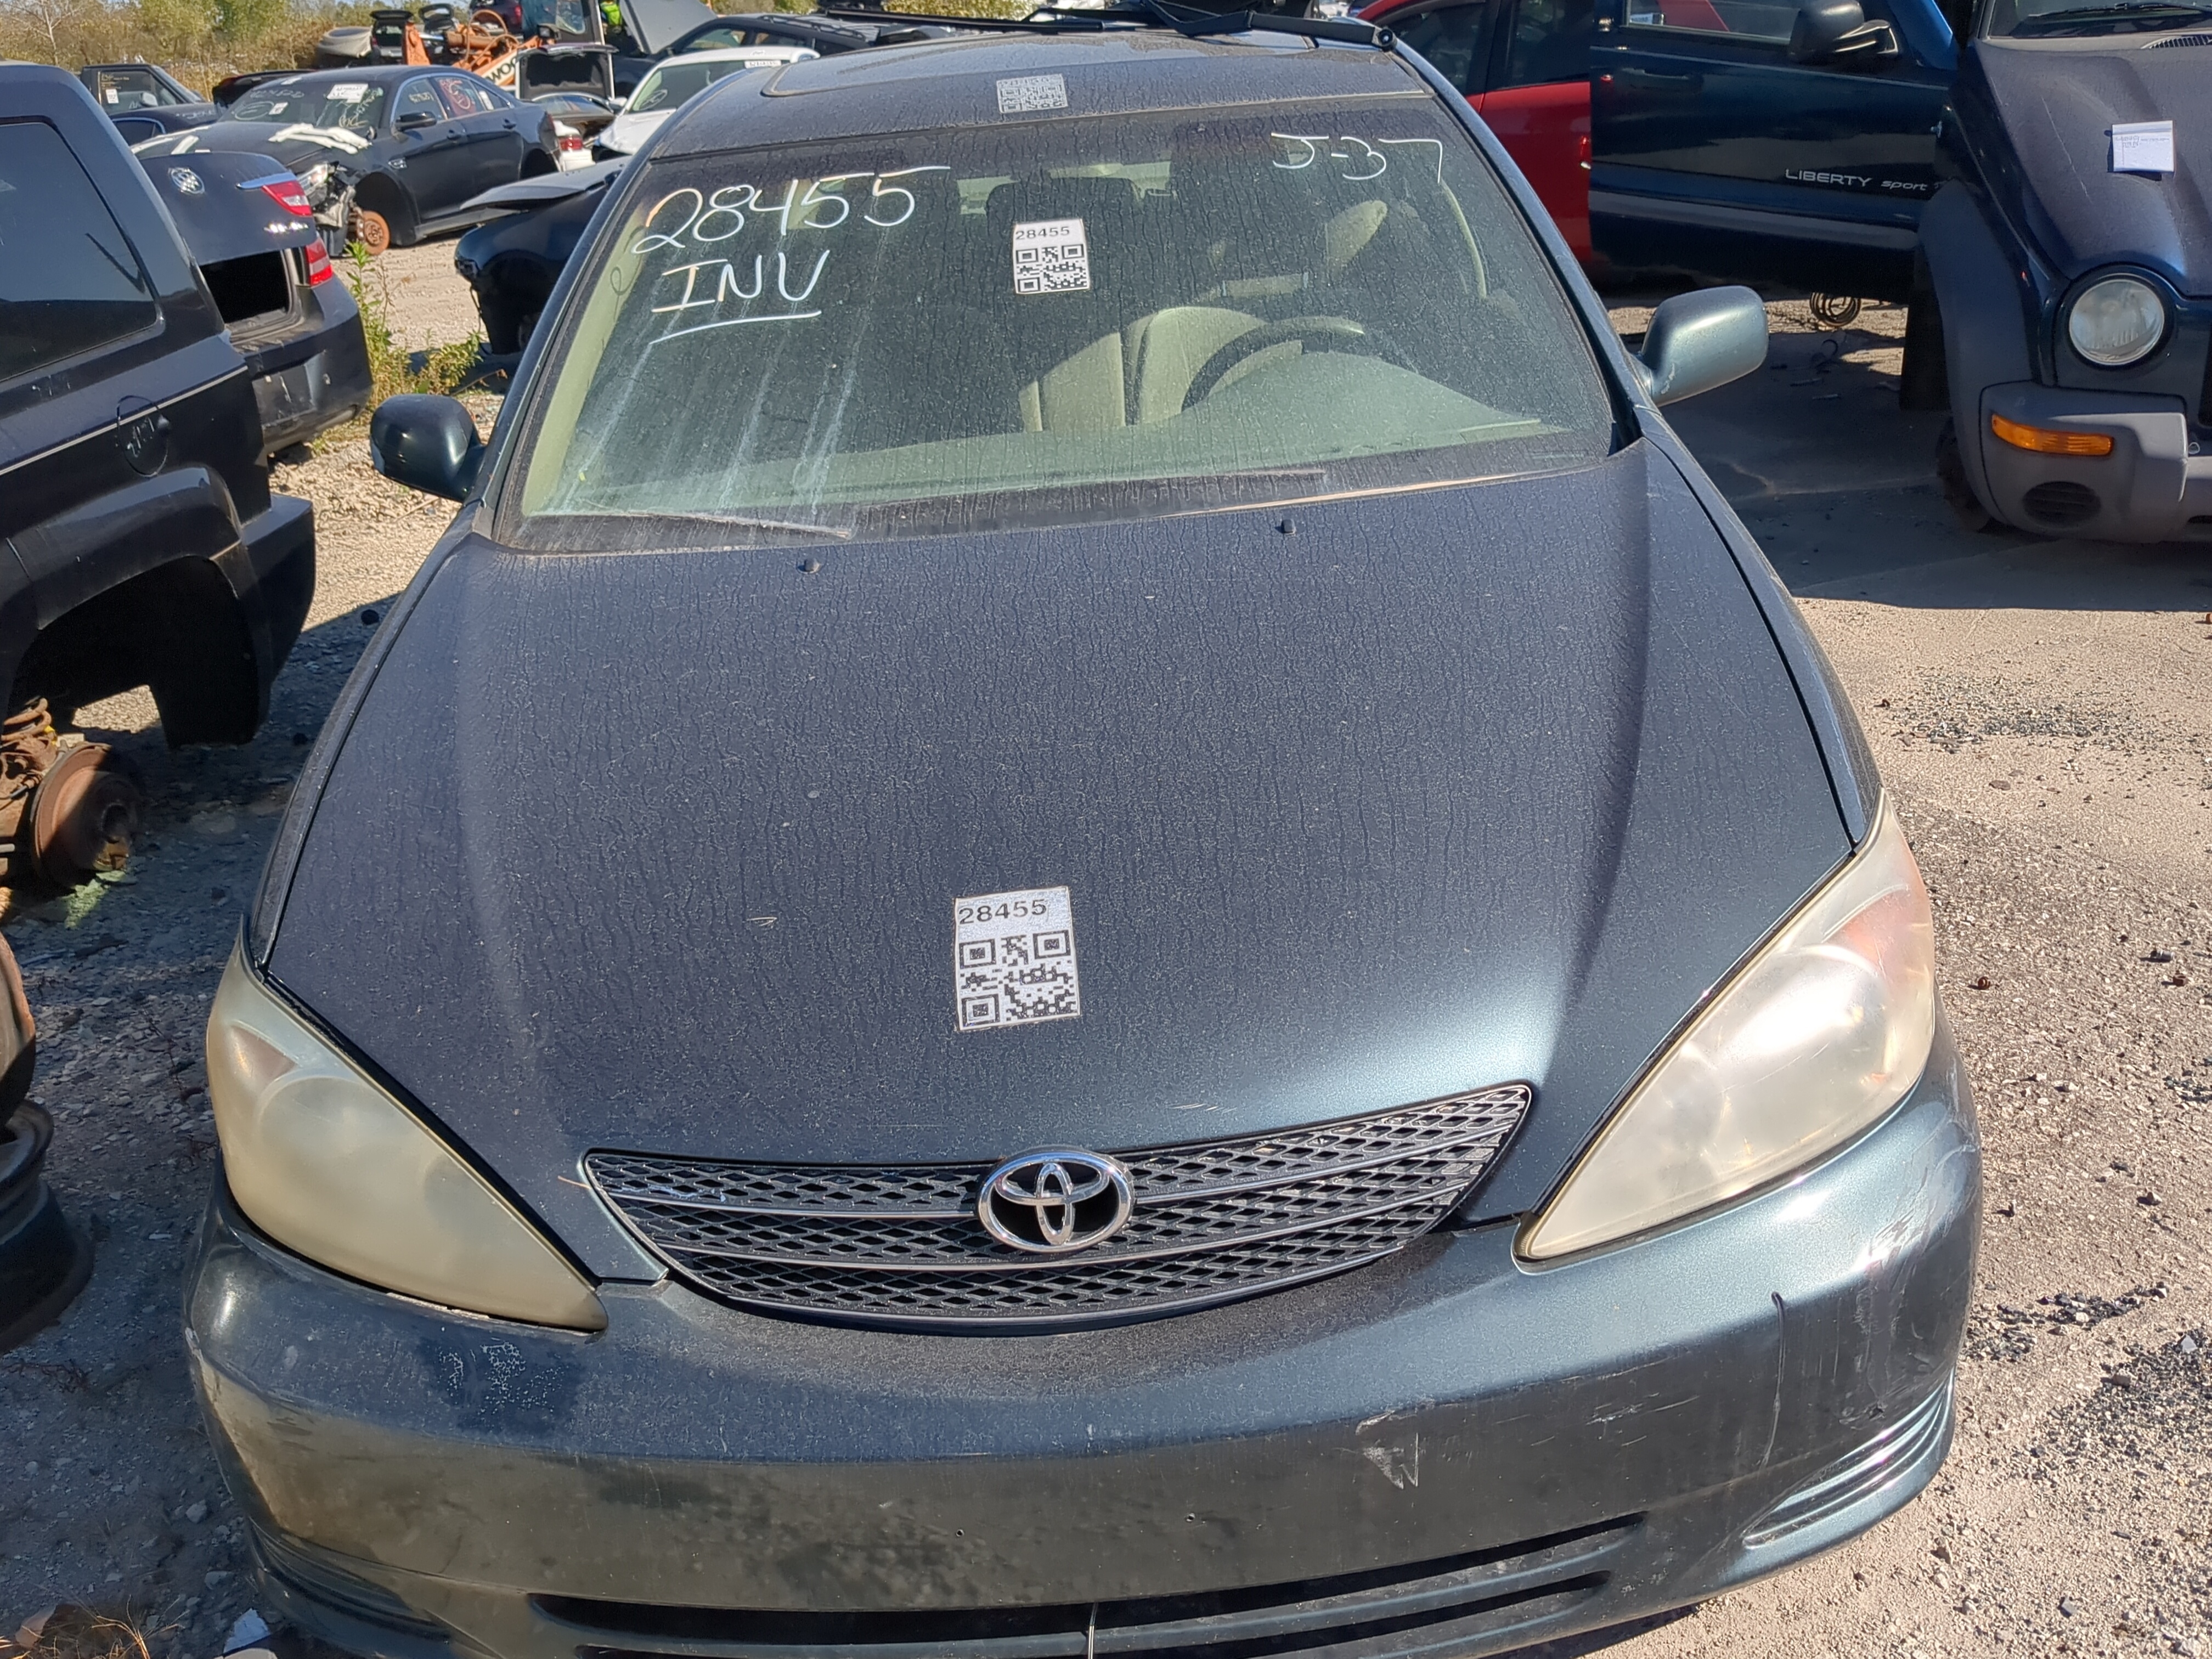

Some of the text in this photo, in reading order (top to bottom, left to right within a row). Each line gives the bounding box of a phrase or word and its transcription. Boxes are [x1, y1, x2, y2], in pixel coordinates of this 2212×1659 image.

[1785, 168, 1928, 191] LIBERTY sport
[630, 166, 951, 255] 28455
[1015, 226, 1070, 240] 28455
[958, 899, 1047, 925] 28455
